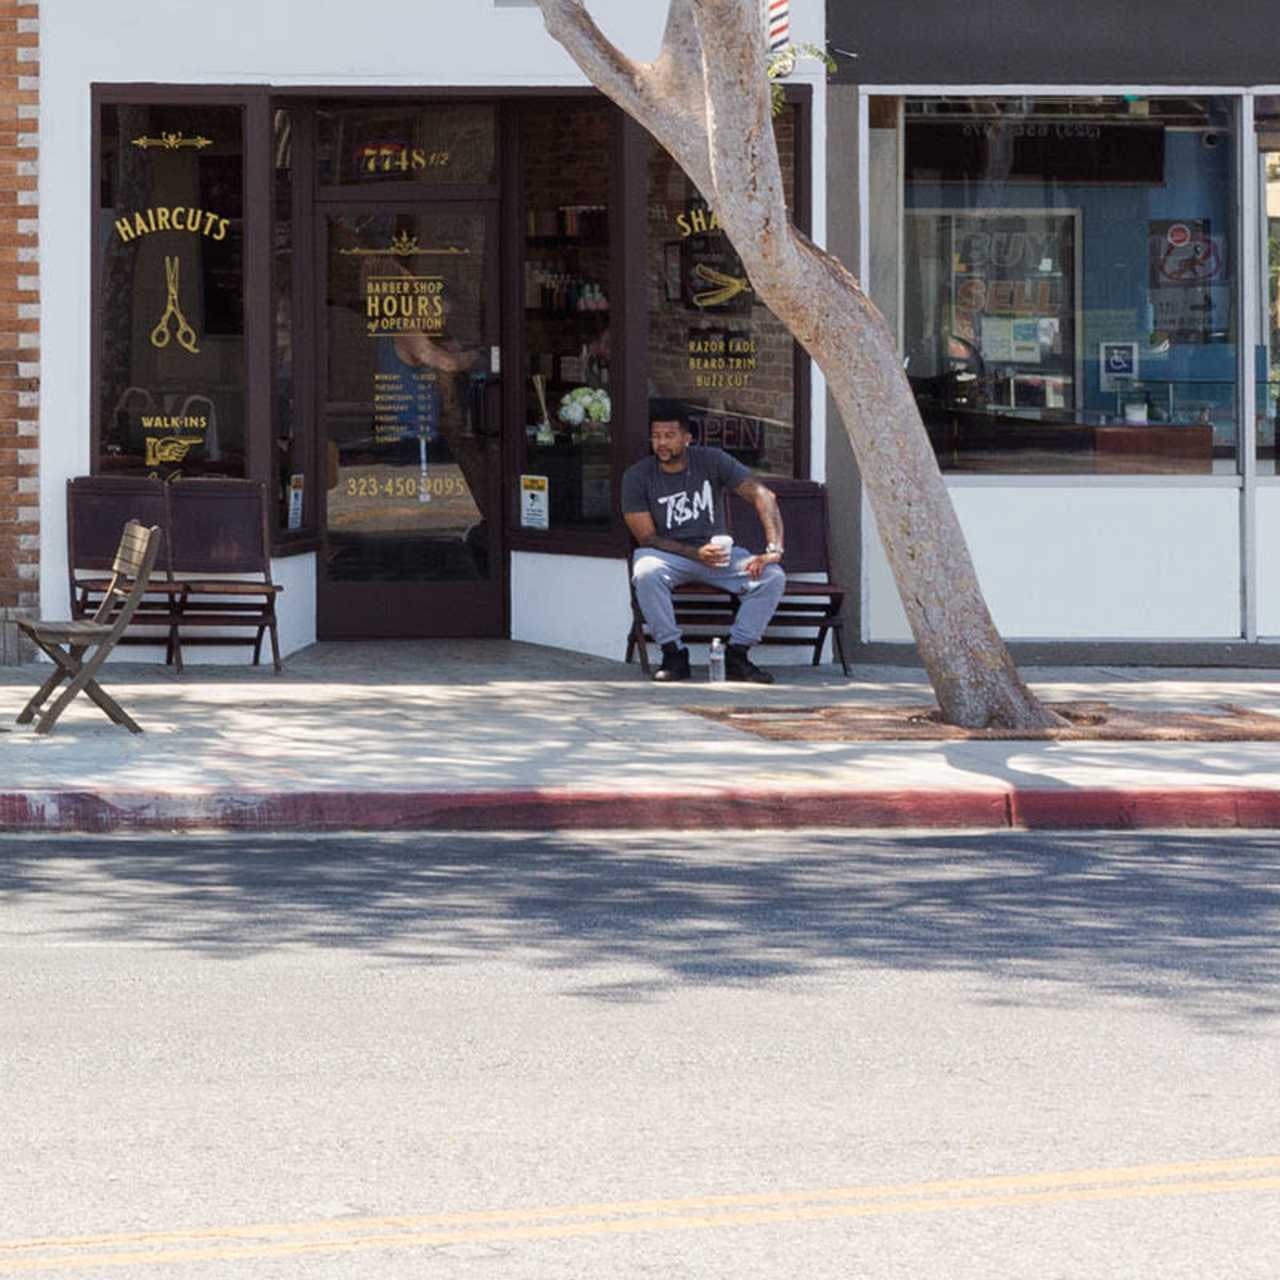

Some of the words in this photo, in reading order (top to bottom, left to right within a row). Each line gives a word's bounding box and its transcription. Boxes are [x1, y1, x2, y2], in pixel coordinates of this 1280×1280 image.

[115, 206, 230, 242] HAIRCUTS
[676, 209, 721, 237] SHA
[367, 282, 410, 294] BARBER
[413, 282, 444, 294] SHOP
[367, 295, 443, 317] HOURS
[381, 318, 443, 330] OPERATION
[688, 341, 726, 353] RAZOR
[728, 341, 757, 353] FADE
[688, 358, 726, 370] BEARD
[728, 358, 757, 370] TRIM
[697, 374, 725, 387] BUZZ
[727, 374, 750, 387] CUT
